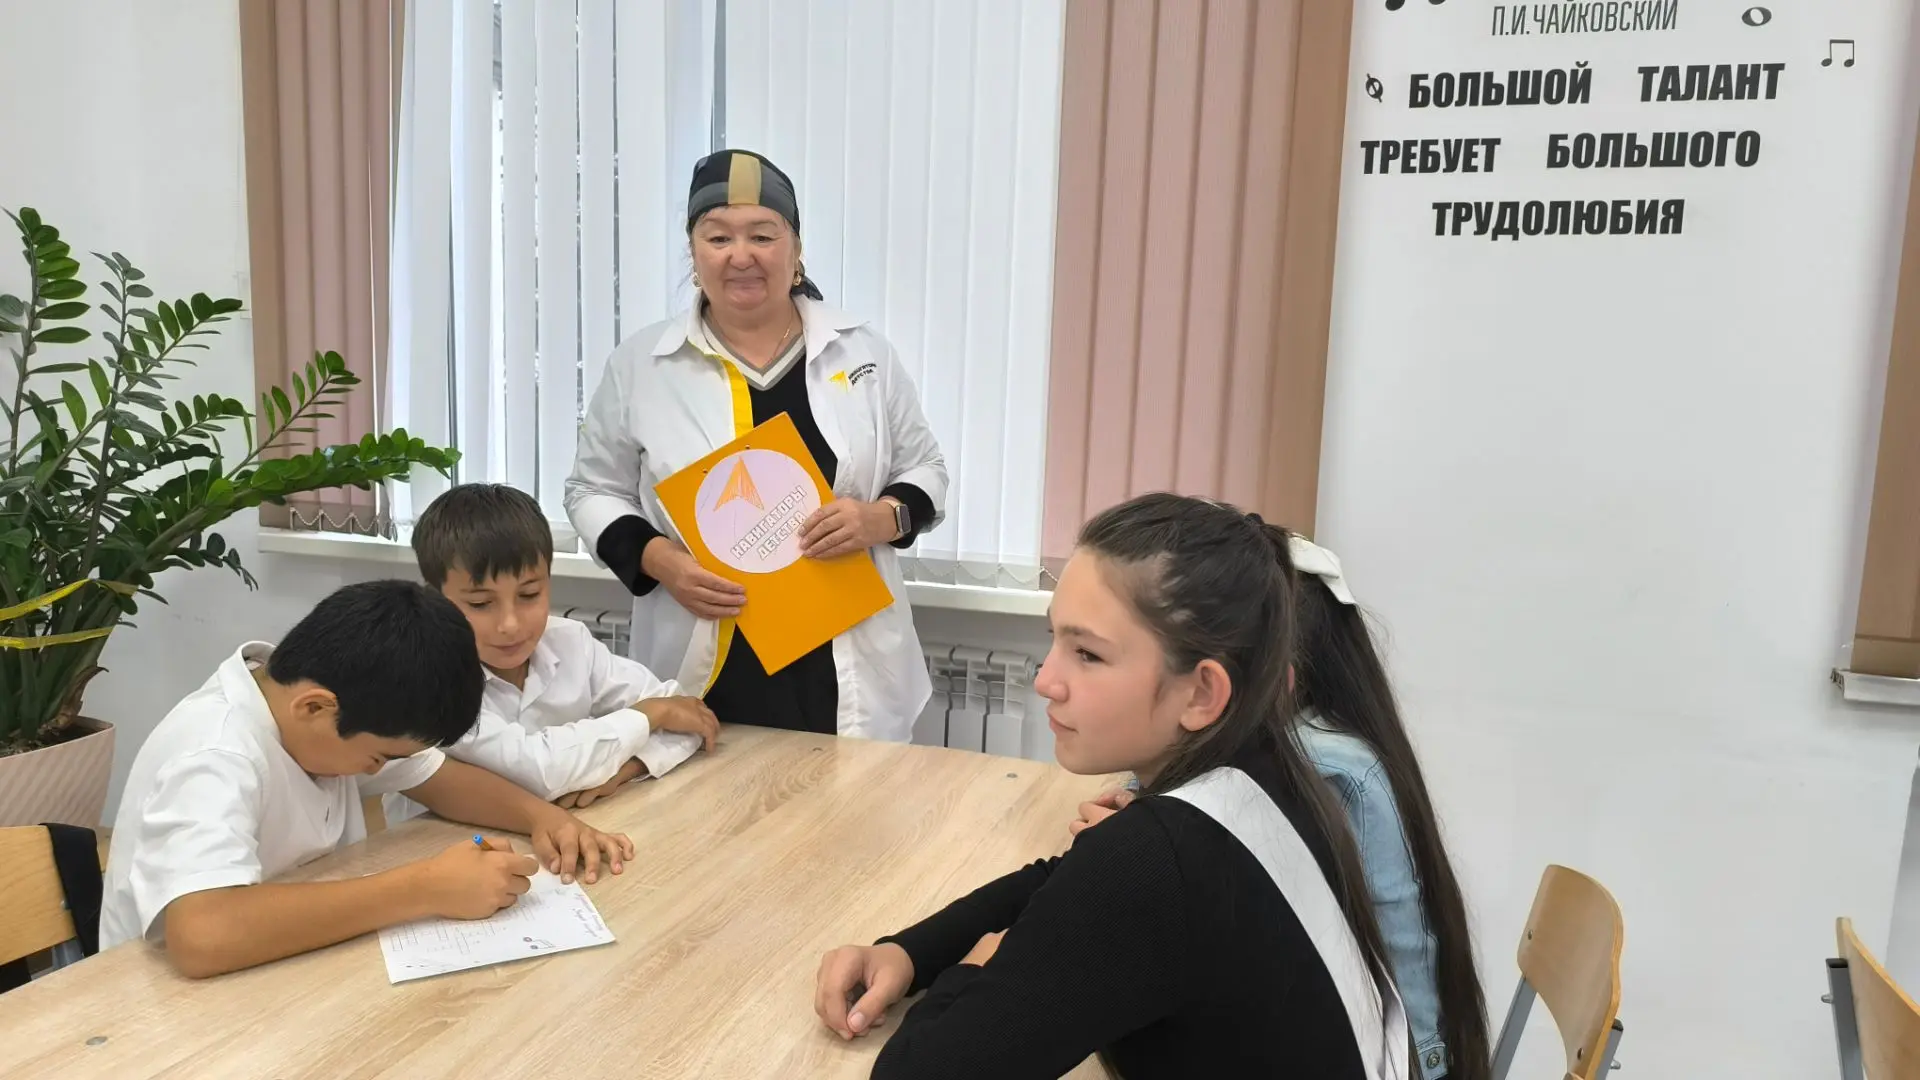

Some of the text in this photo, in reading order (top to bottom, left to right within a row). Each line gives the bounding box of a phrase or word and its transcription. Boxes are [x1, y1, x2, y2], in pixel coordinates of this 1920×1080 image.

[1409, 61, 1785, 108] БОЛЬШОЙ ТАЛАНТ
[1361, 131, 1760, 175] ТРЕБУЕТ БОЛЬШОГО
[1432, 199, 1685, 242] ТРУДОЛЮБИЯ
[730, 485, 807, 560] НАВИГАТОРЫ
[757, 510, 807, 561] ДЕТСТВА
